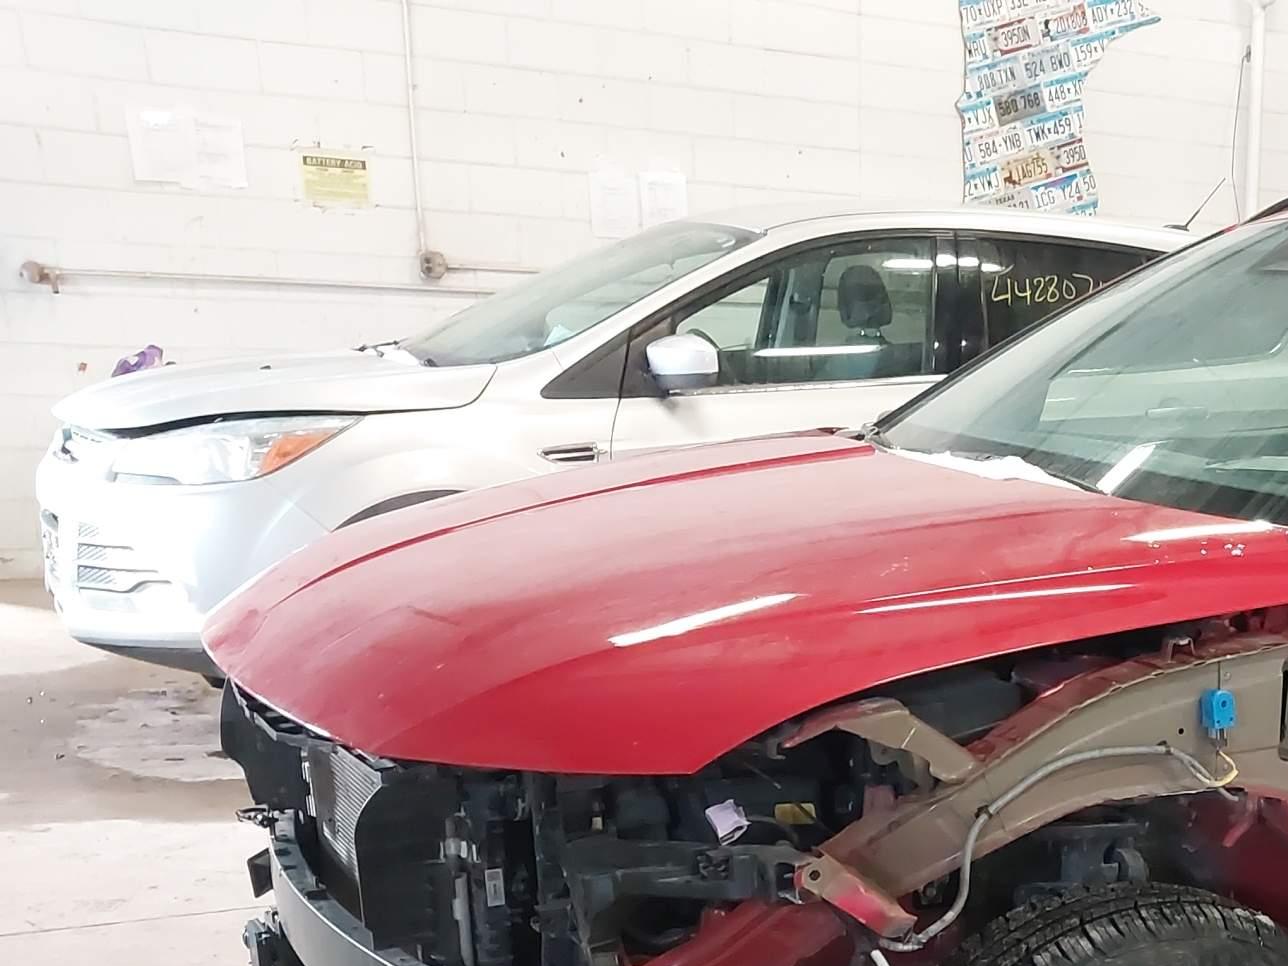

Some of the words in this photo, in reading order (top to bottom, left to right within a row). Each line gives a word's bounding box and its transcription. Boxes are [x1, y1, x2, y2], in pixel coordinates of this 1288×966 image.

[1024, 59, 1046, 80] 524
[1048, 84, 1068, 103] 448
[1052, 118, 1072, 135] 459
[991, 264, 1103, 306] 442807
